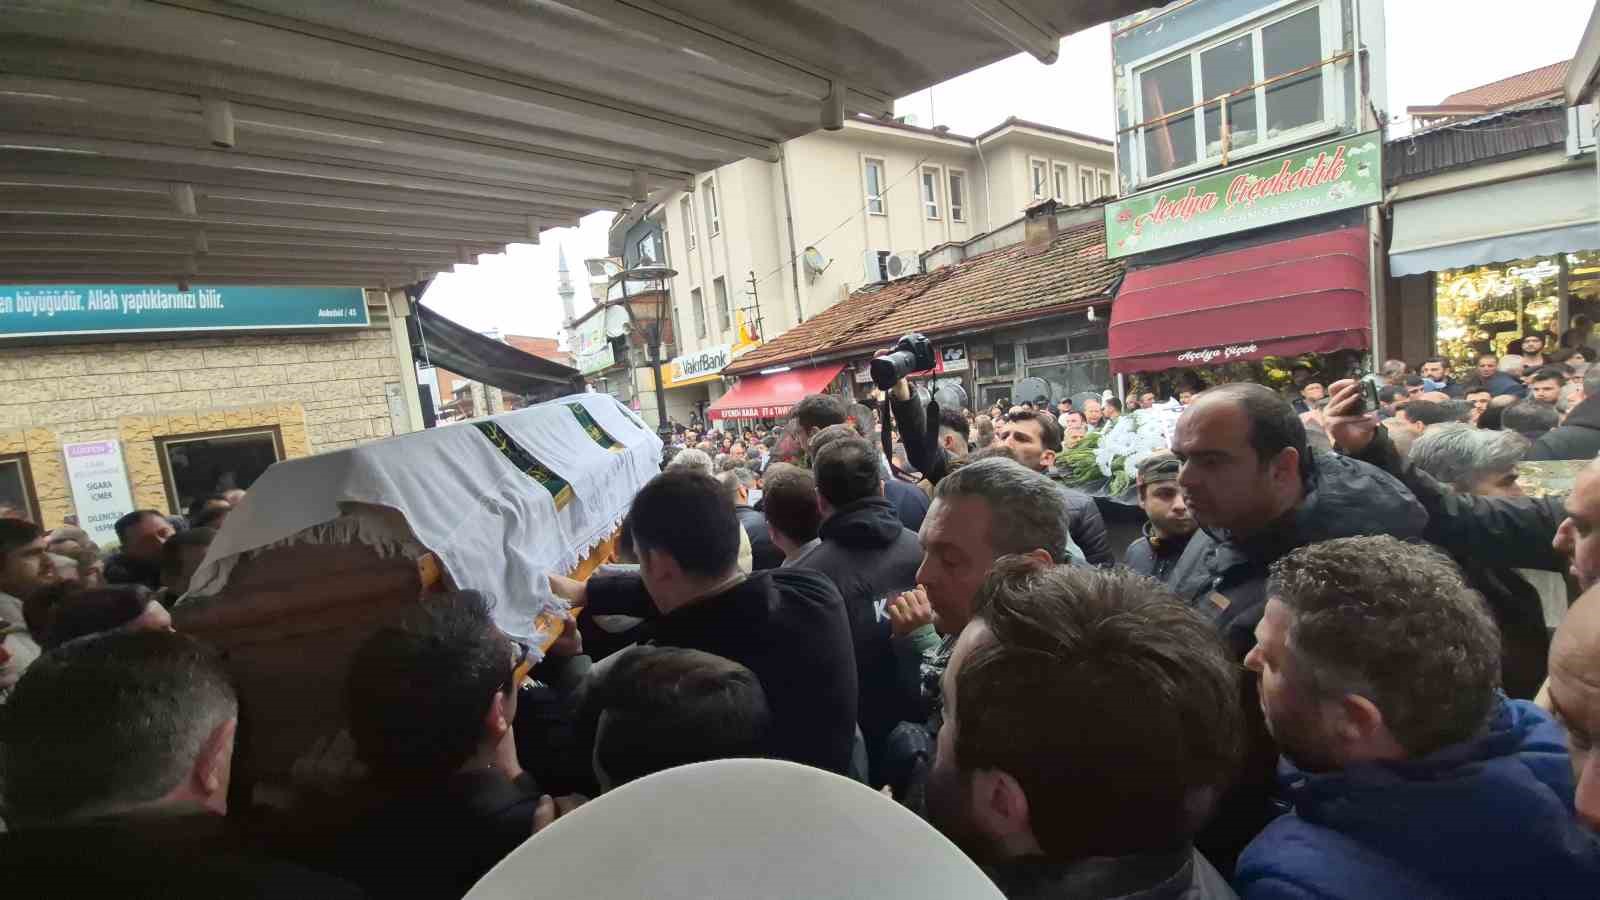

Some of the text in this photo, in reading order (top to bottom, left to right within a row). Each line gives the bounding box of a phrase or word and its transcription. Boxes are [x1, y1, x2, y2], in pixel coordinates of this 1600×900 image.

[16, 290, 85, 317] büyüğüdür.
[88, 289, 118, 311] Allah
[199, 289, 224, 309] bilir.
[683, 350, 726, 375] VakıfBank
[86, 479, 112, 491] SİGARA
